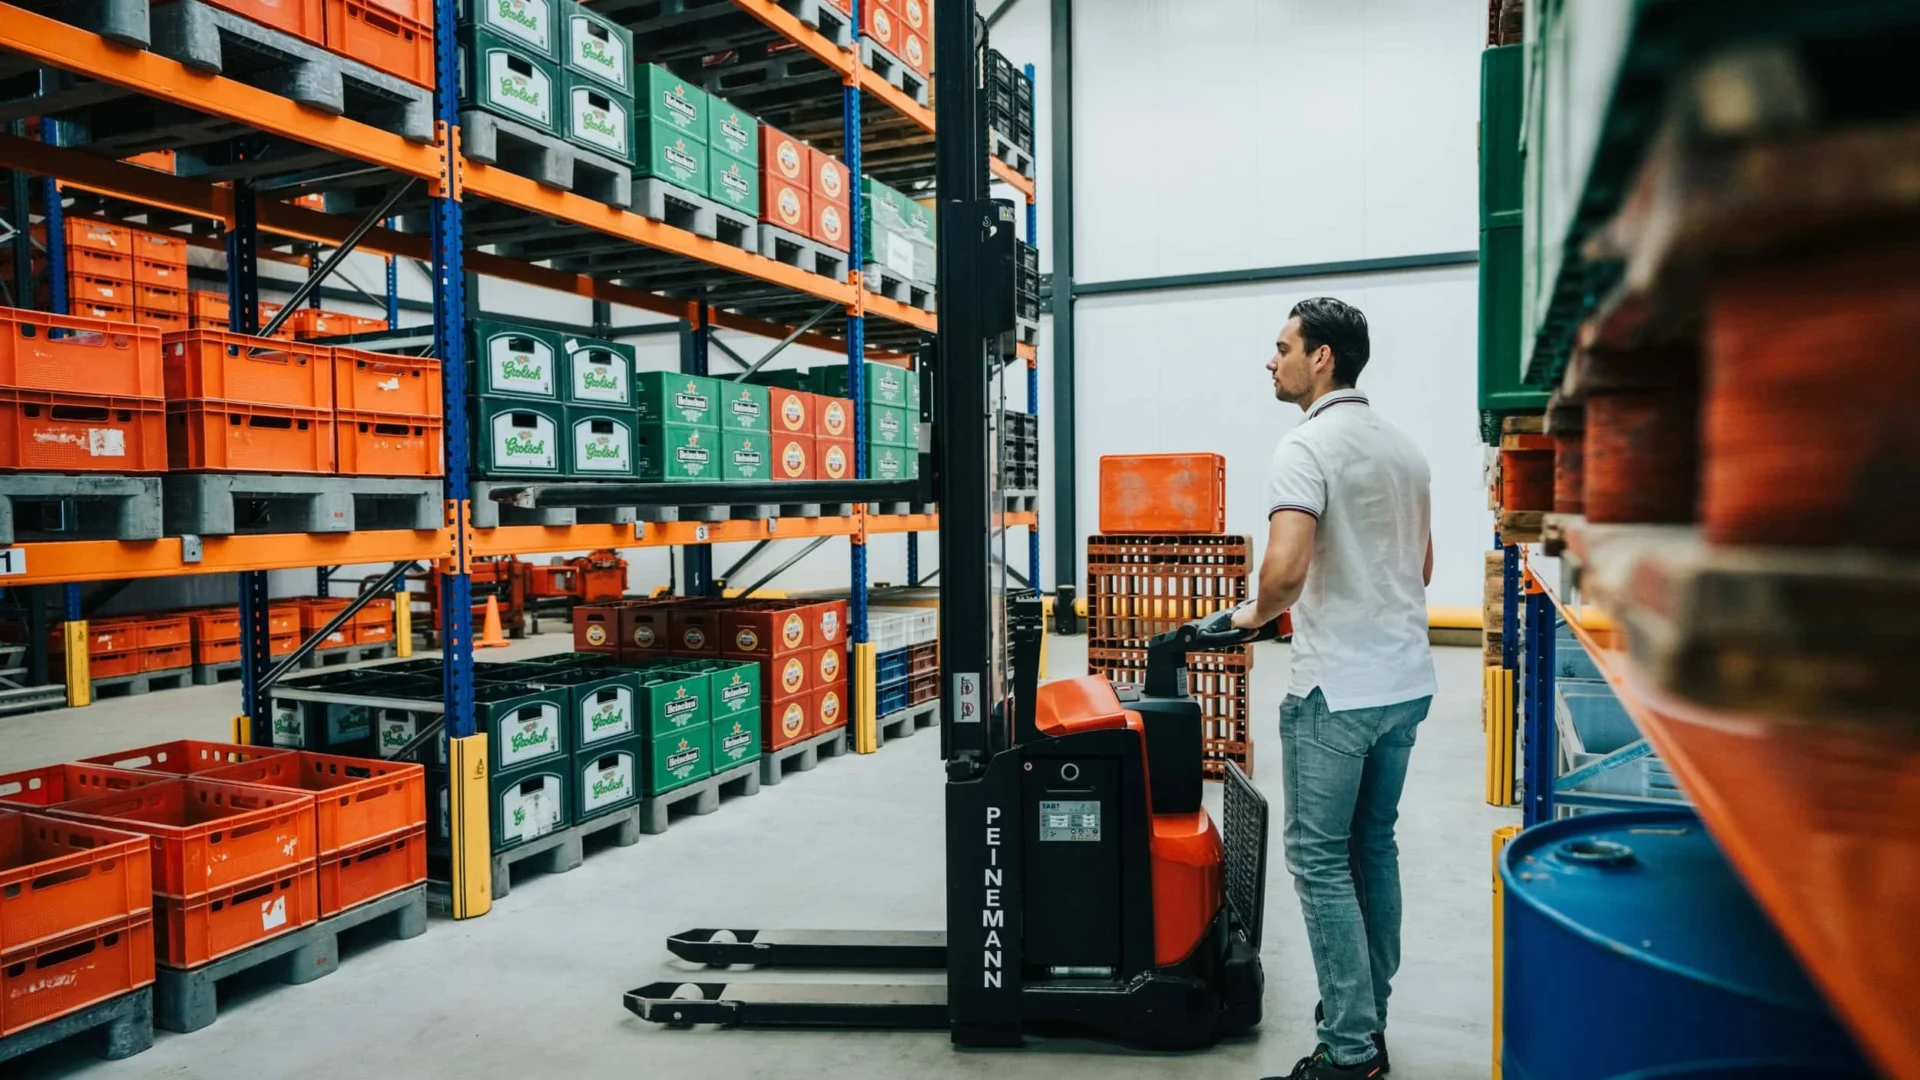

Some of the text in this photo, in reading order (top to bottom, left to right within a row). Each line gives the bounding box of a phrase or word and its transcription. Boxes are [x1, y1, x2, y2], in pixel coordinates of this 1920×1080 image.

[501, 76, 539, 106] Grolsch
[502, 361, 541, 380] Grolsch
[583, 372, 617, 389] Grolsch
[505, 437, 544, 456] Grolsch
[585, 443, 620, 460] Grolsch
[698, 527, 705, 539] 3
[0, 551, 11, 572] 1
[667, 700, 696, 715] Heineken
[592, 708, 623, 731] Grolsch
[511, 727, 548, 752] Grolsch
[669, 752, 698, 768] Heineken
[593, 774, 624, 799] Grolsch
[983, 807, 1004, 988] PEINEMANN
